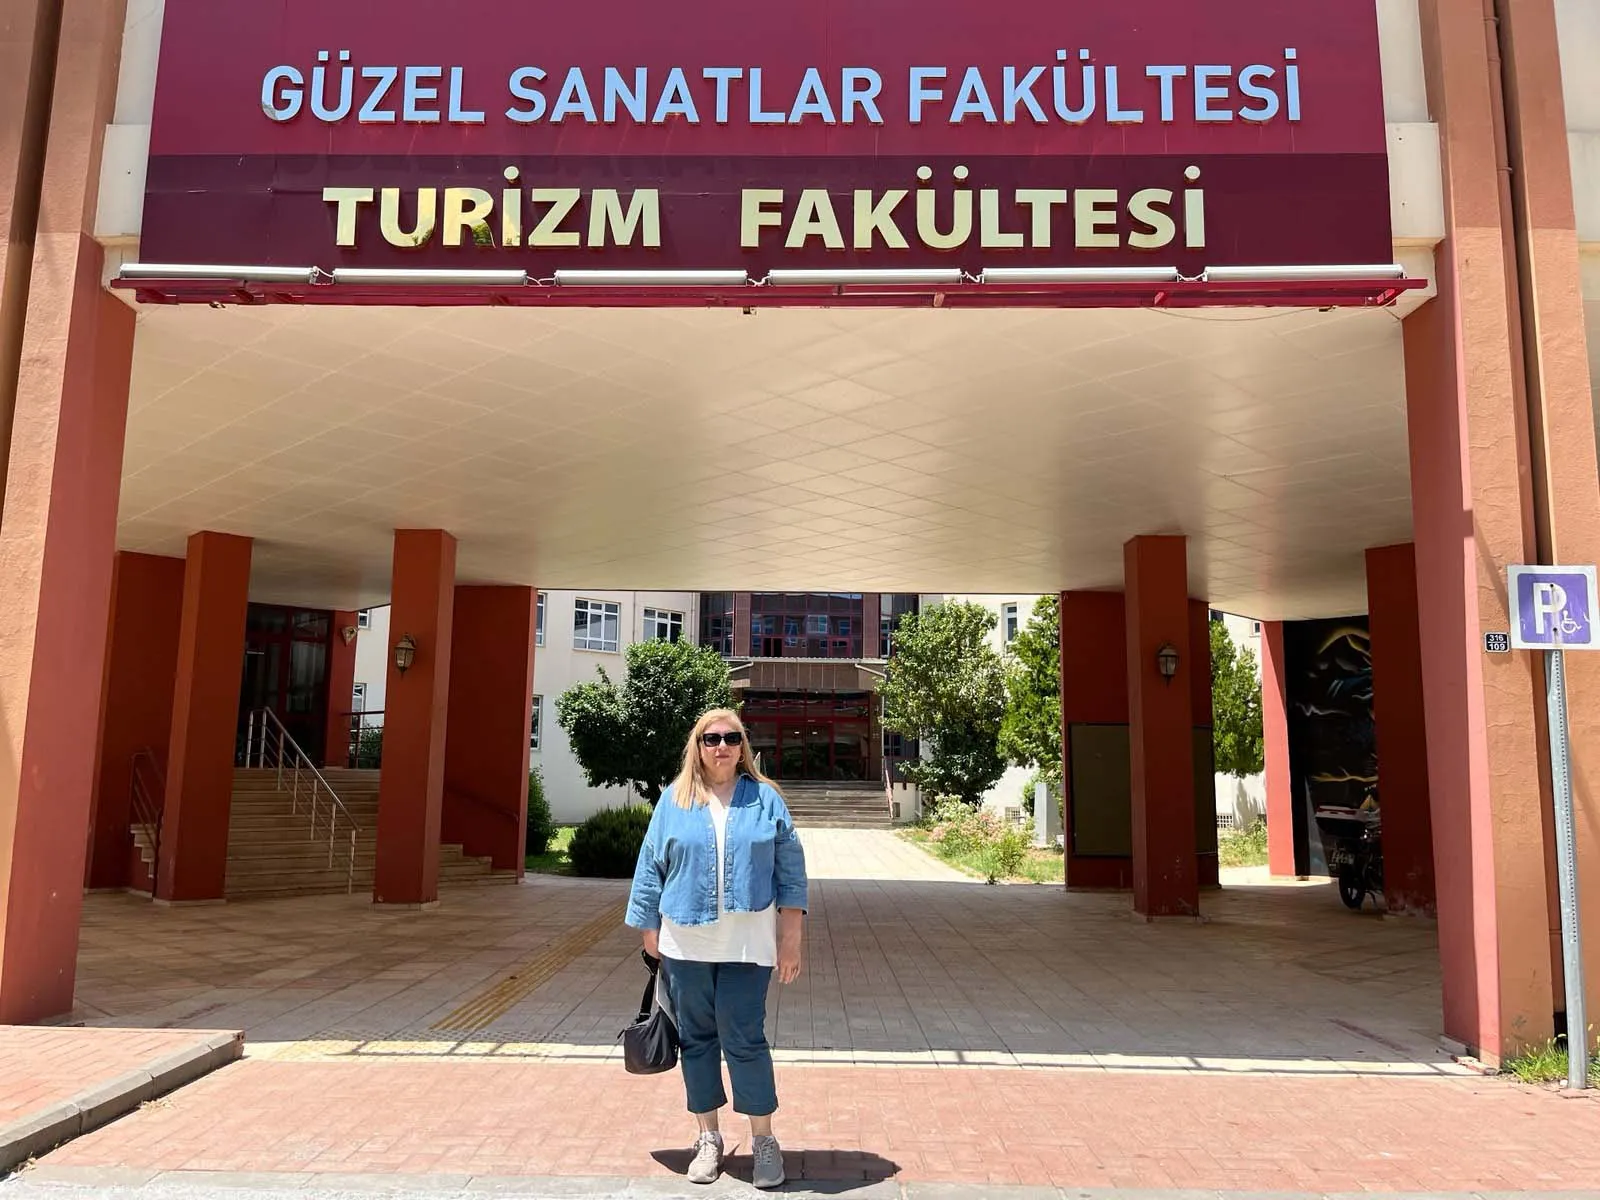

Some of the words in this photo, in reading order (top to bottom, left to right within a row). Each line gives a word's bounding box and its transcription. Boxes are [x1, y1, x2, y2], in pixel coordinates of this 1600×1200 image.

[261, 50, 486, 124] GÜZEL
[505, 66, 884, 125] SANATLAR
[908, 48, 1302, 125] FAKÜLTESİ
[323, 166, 662, 249] TURİZM
[740, 165, 1206, 250] FAKÜLTESİ
[1533, 582, 1567, 634] P
[1489, 643, 1505, 651] 109
